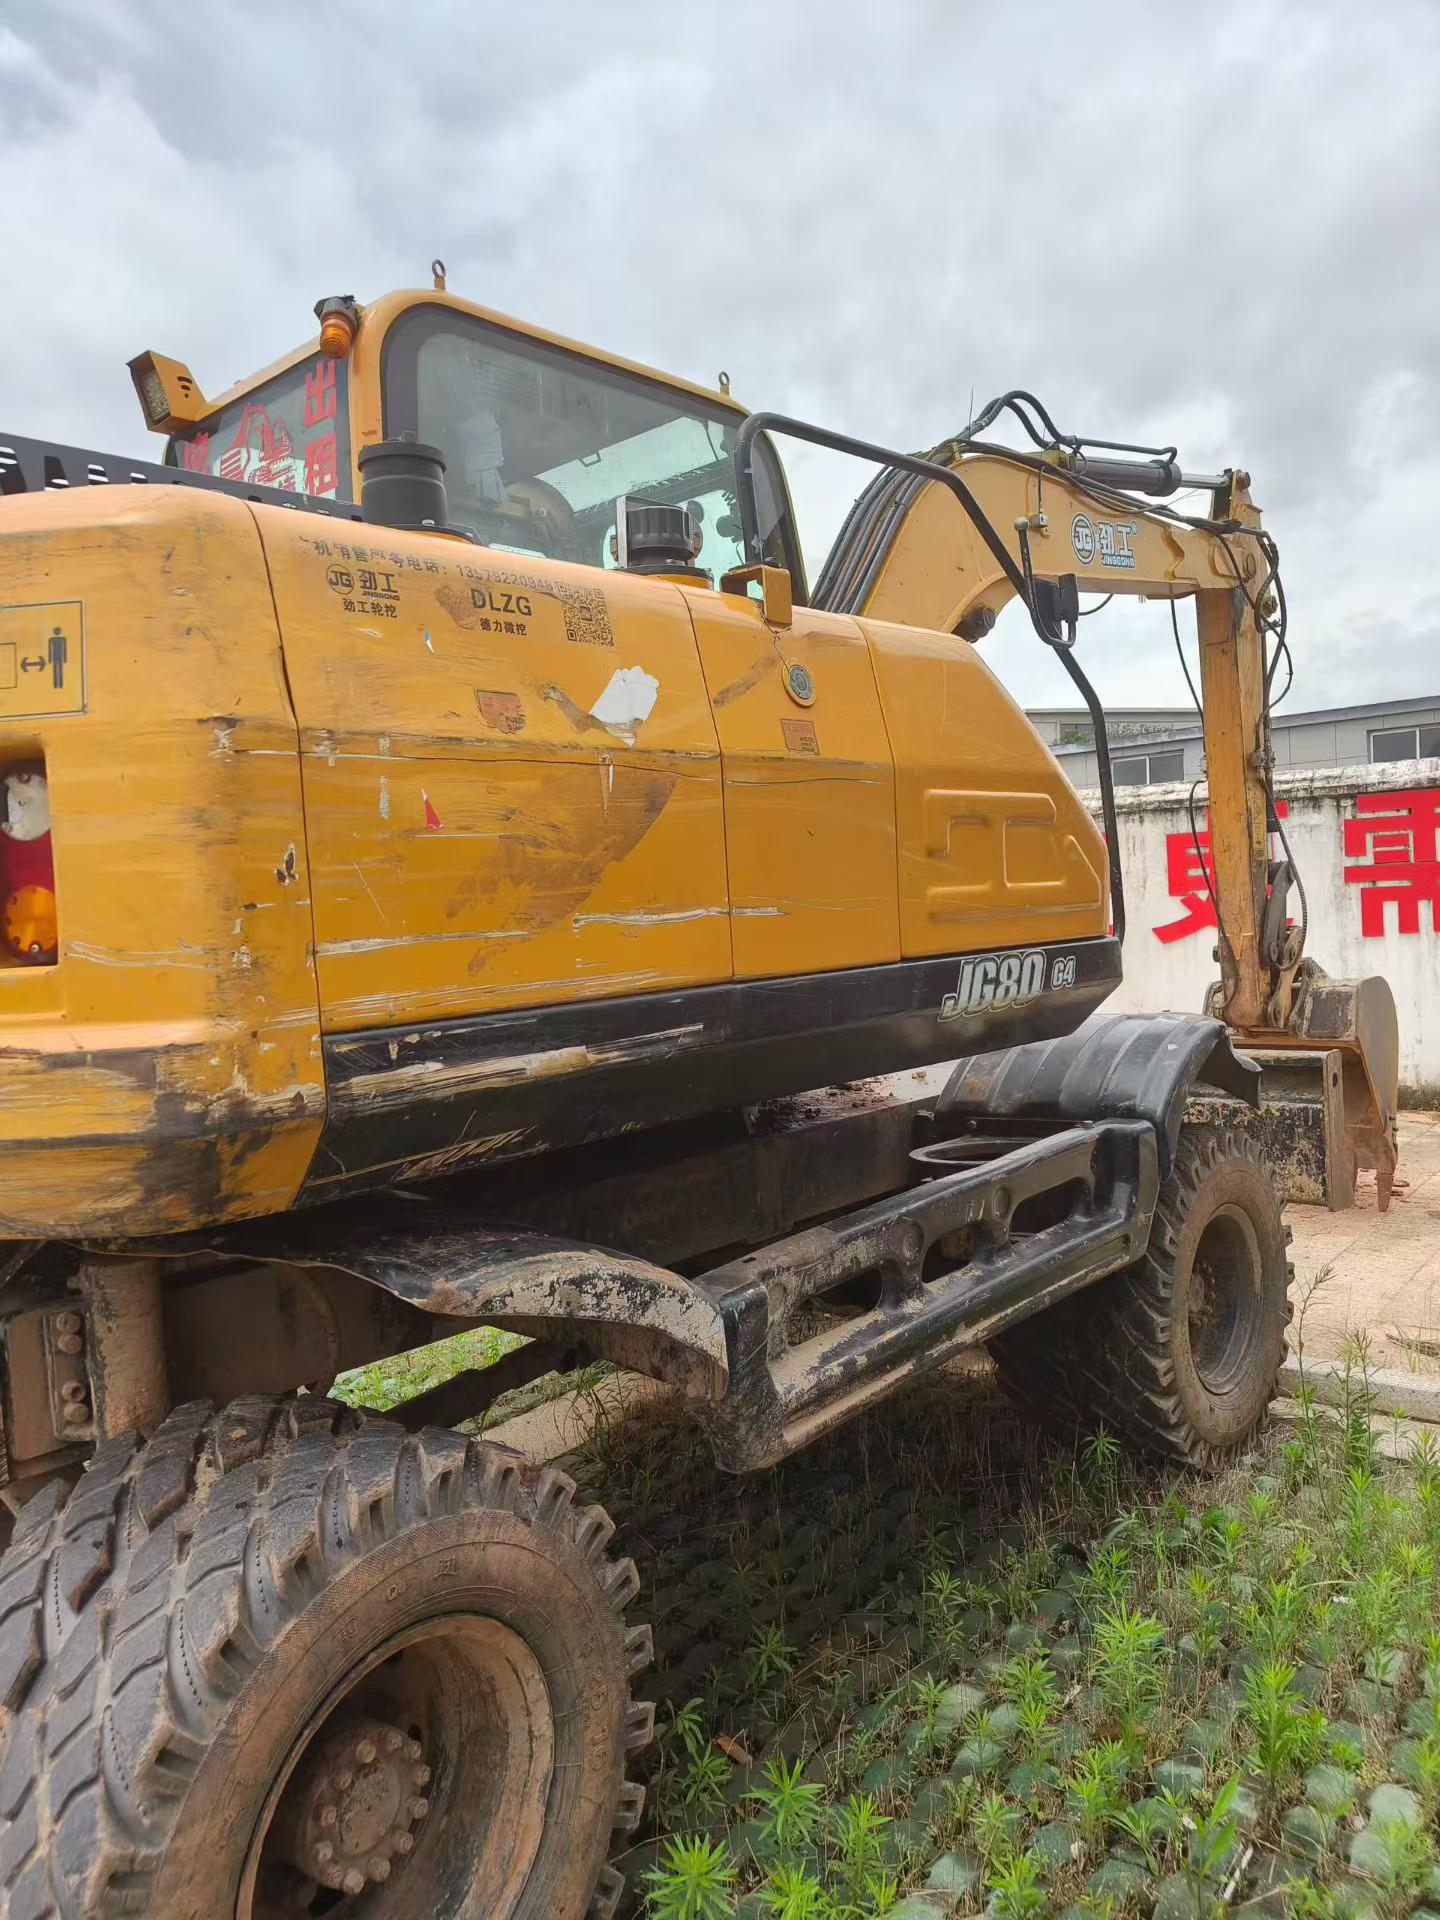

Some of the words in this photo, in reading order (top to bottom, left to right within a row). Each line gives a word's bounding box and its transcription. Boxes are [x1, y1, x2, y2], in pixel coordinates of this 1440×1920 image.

[470, 587, 533, 616] DLZG
[480, 617, 528, 636] 德力微挖
[938, 949, 1046, 1021] JG80
